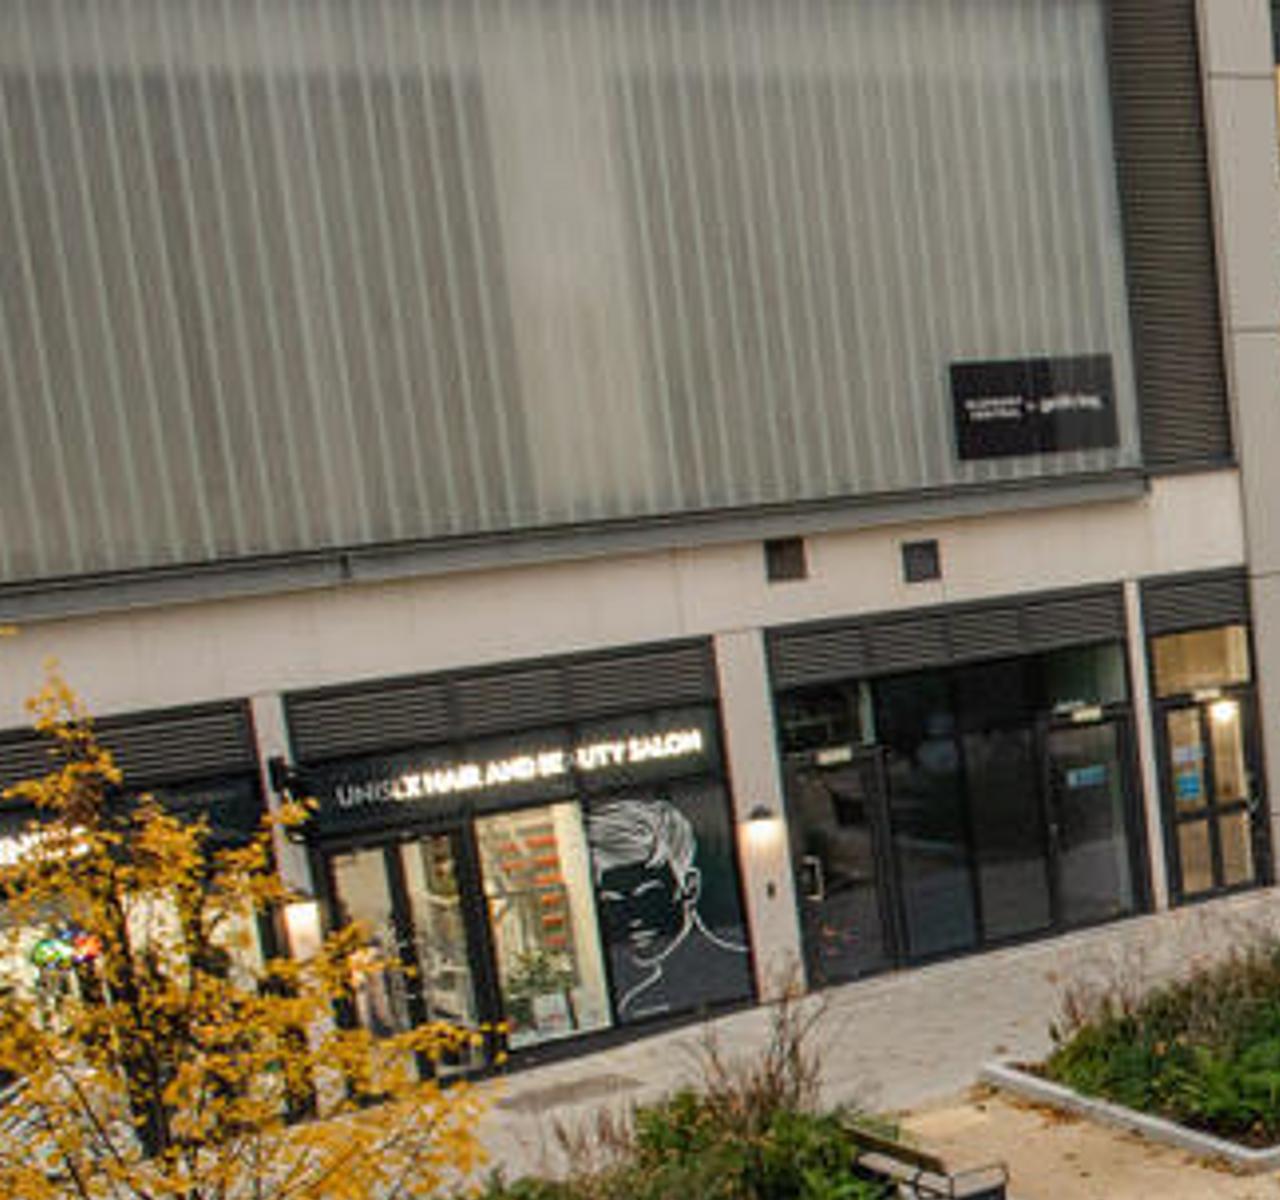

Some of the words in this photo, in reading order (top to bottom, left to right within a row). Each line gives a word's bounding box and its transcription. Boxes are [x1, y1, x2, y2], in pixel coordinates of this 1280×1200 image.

[421, 763, 482, 795] HAIR
[485, 753, 536, 786] AND
[627, 728, 702, 763] SALON
